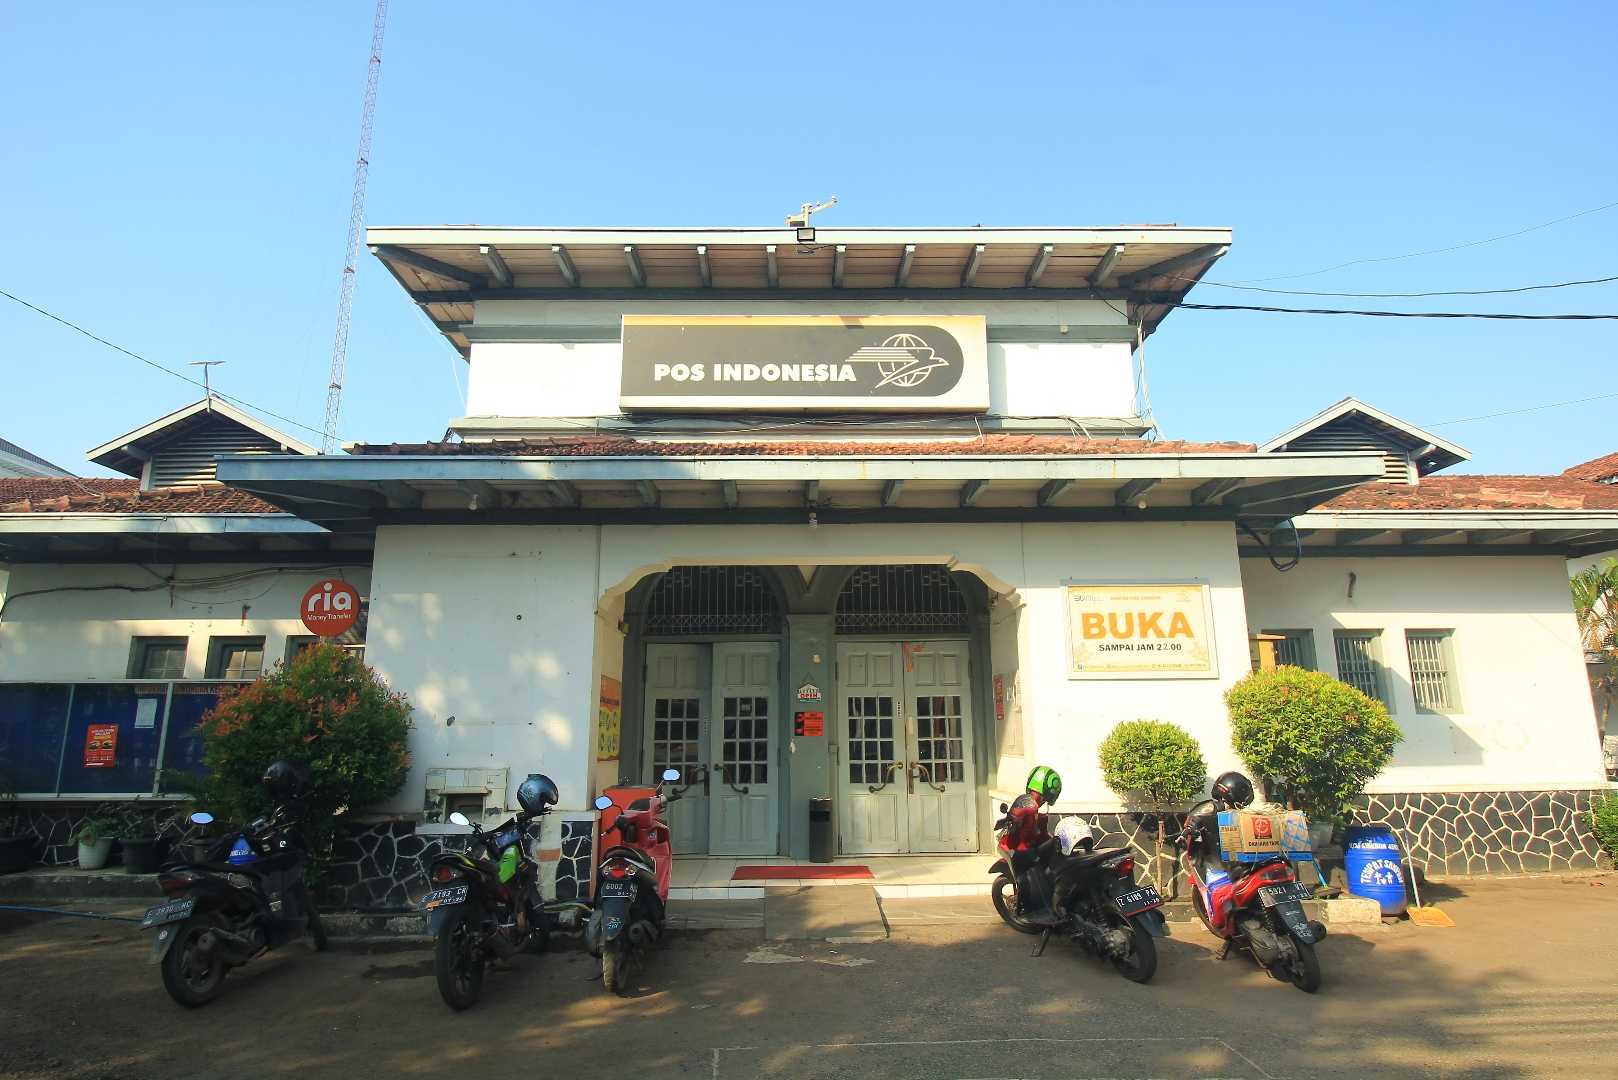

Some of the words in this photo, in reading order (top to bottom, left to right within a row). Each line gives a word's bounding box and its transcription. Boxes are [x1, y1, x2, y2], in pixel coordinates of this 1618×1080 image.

[654, 363, 705, 381] POS
[714, 363, 857, 382] INDONESIA
[307, 582, 352, 612] ria
[1081, 611, 1194, 639] BUKA
[1099, 643, 1134, 652] SAMPAI
[1136, 643, 1154, 651] JAM
[1156, 643, 1182, 651] 22.00
[1360, 859, 1383, 884] TEMPAT
[1118, 898, 1125, 906] Z
[1145, 888, 1155, 897] PA
